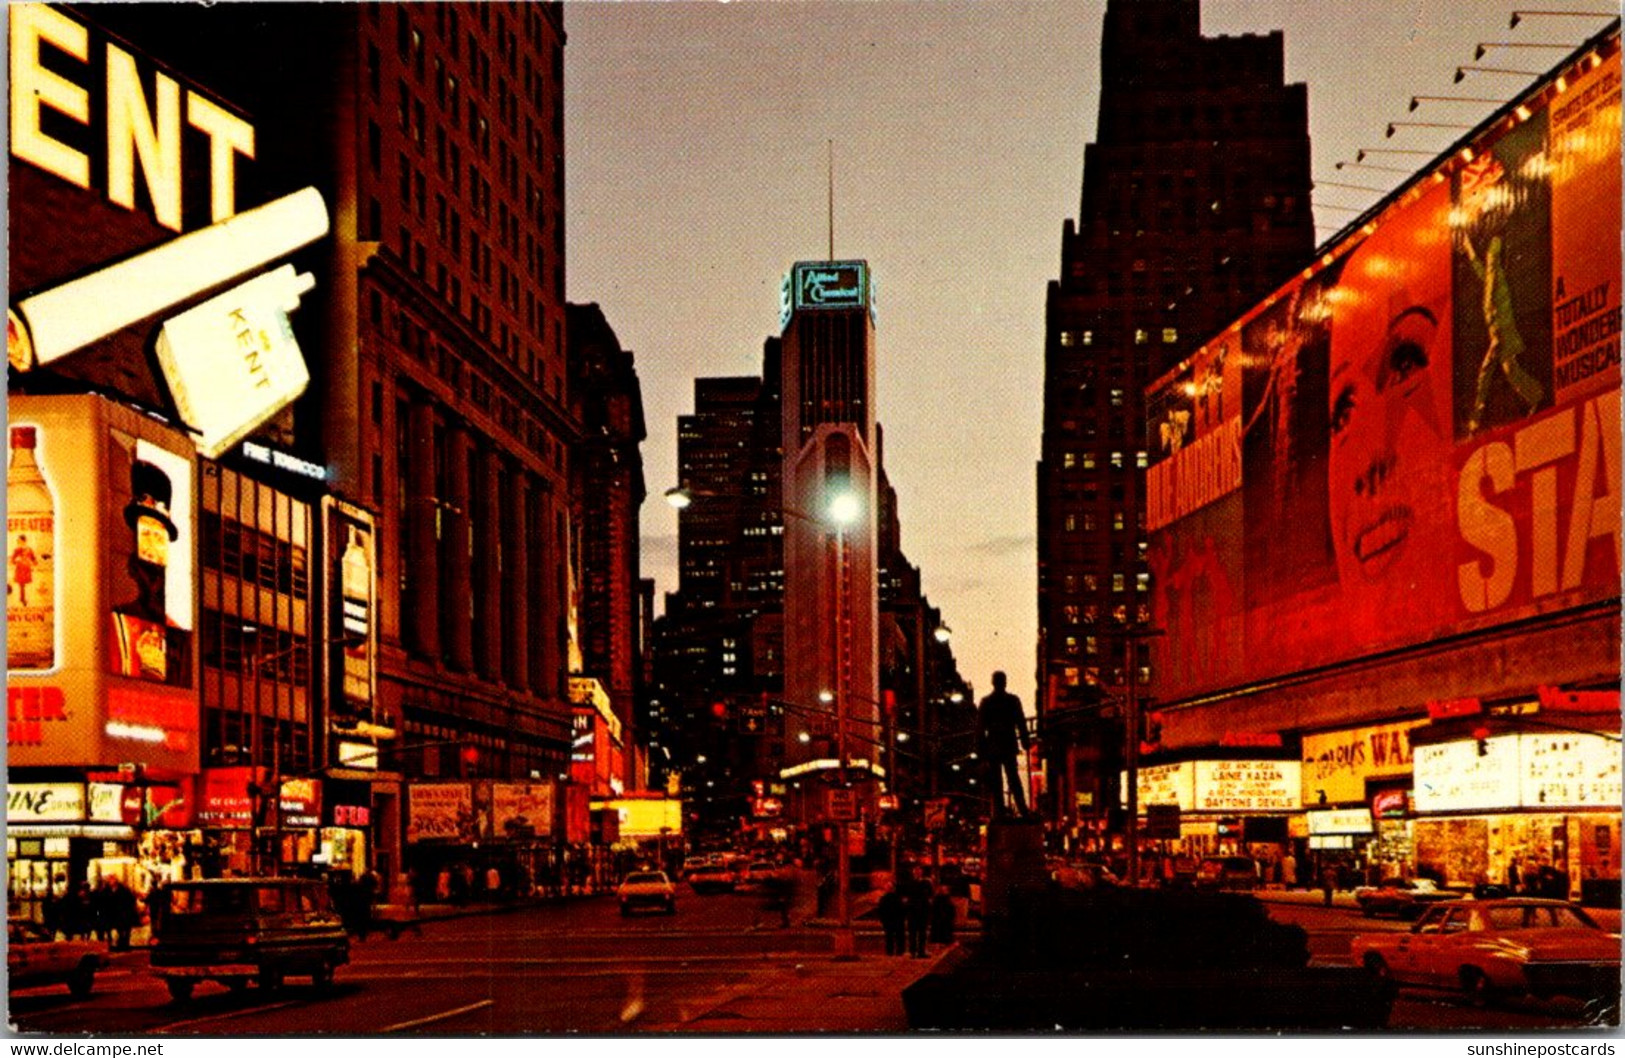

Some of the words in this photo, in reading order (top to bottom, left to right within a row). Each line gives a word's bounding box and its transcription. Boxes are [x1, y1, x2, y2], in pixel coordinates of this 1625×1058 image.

[1557, 276, 1566, 299] A
[1556, 280, 1610, 329] TOTALLY
[228, 308, 271, 390] KENT
[273, 450, 325, 480] TOBACCO
[1458, 388, 1622, 612] STA
[1247, 771, 1284, 782] KAZAN
[8, 789, 53, 814] INE
